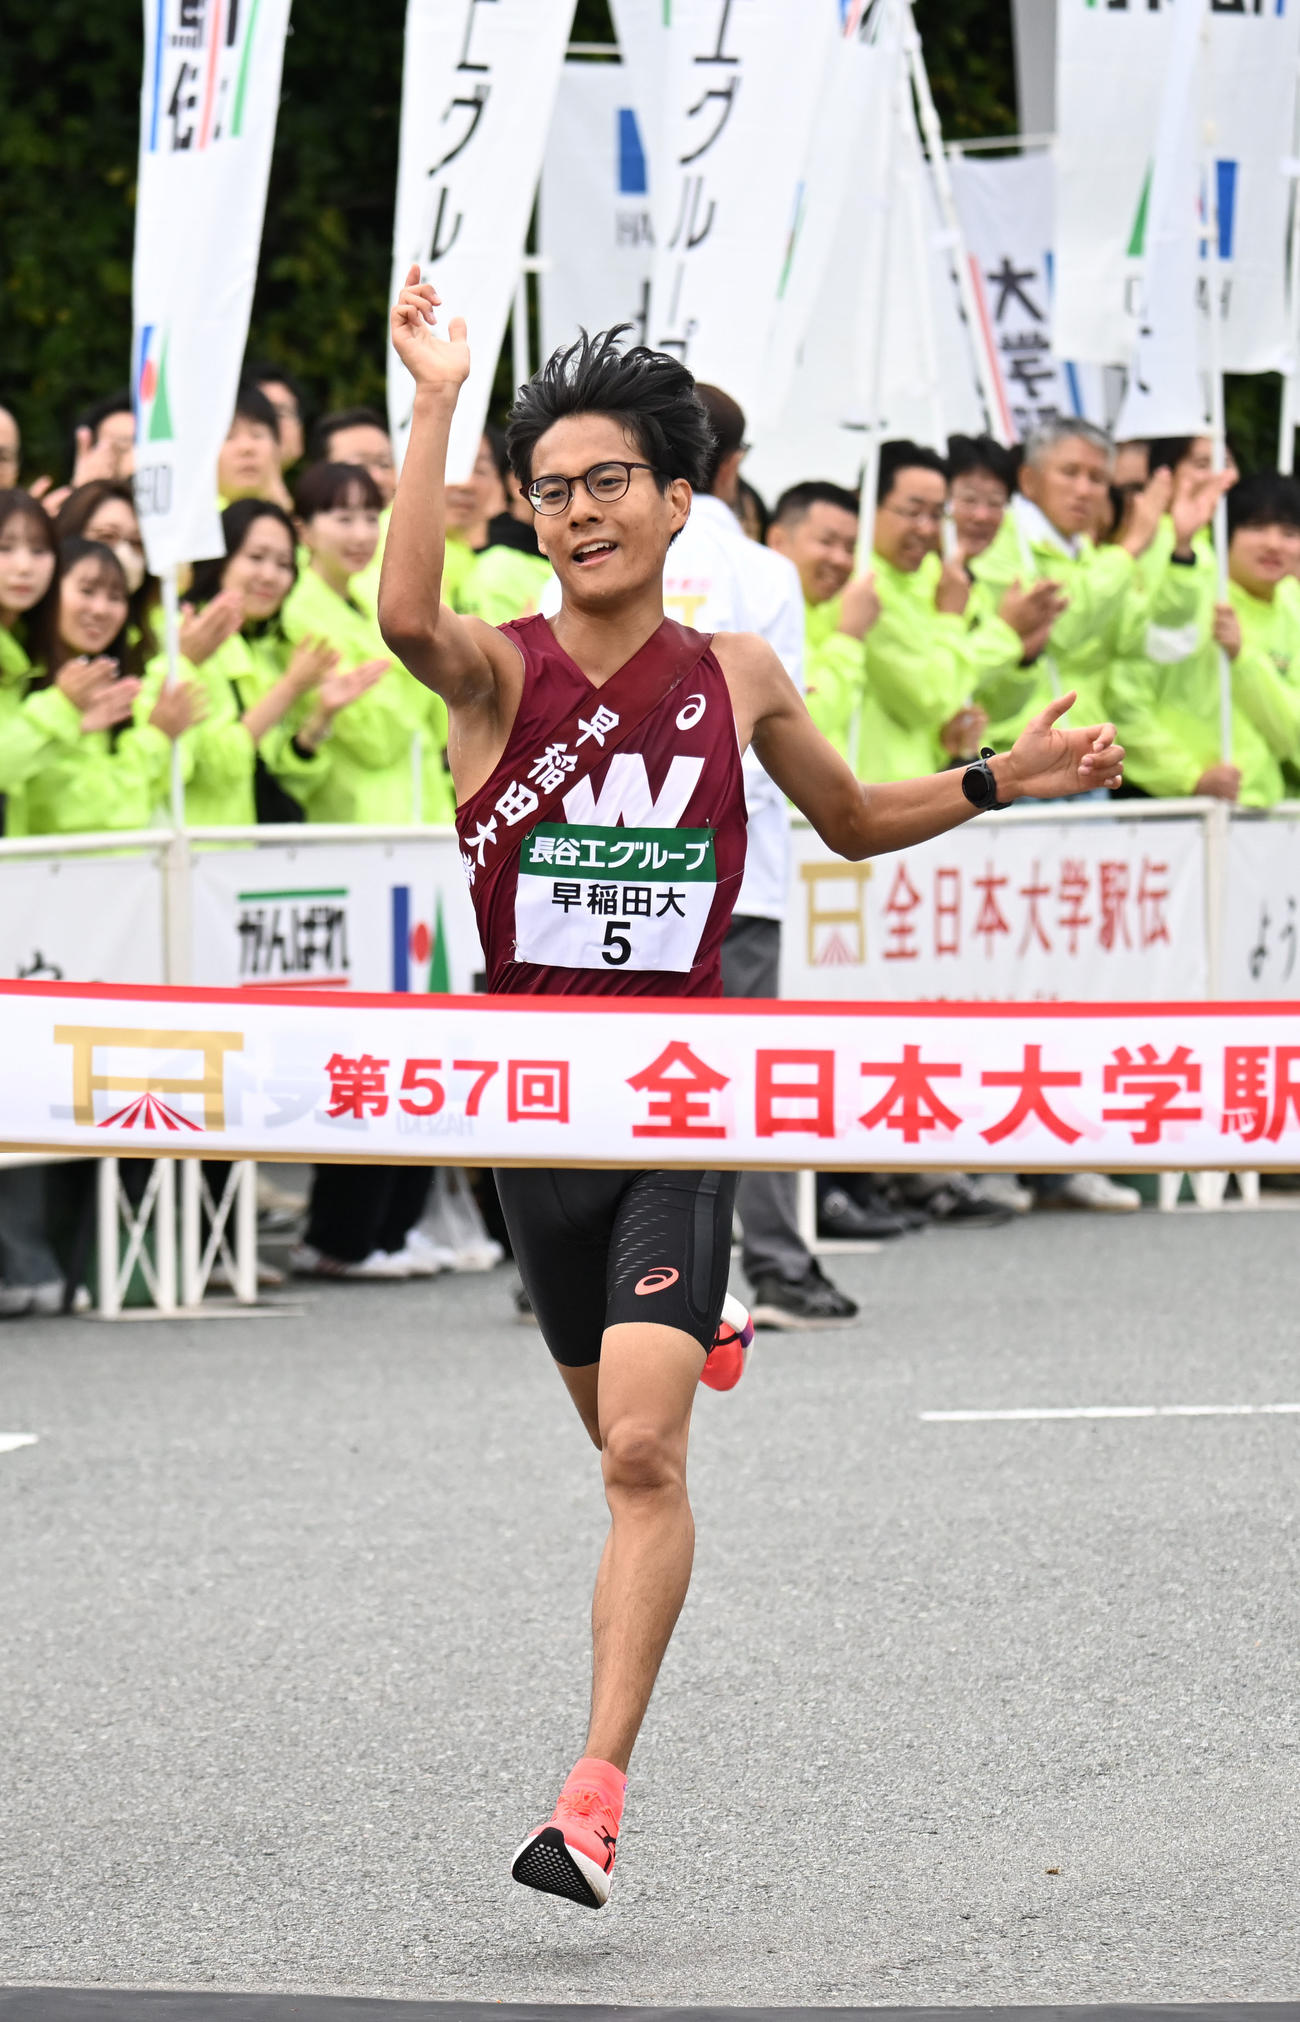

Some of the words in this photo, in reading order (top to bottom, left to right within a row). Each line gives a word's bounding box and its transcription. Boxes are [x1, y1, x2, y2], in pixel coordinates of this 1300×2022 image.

[551, 881, 686, 918] 早稲田大
[882, 856, 1171, 962] 全日本大学駅伝
[237, 905, 349, 976] がんばれ
[601, 920, 632, 966] 5
[324, 1053, 571, 1125] 第57回
[626, 1040, 1300, 1145] 全日本大学駅
